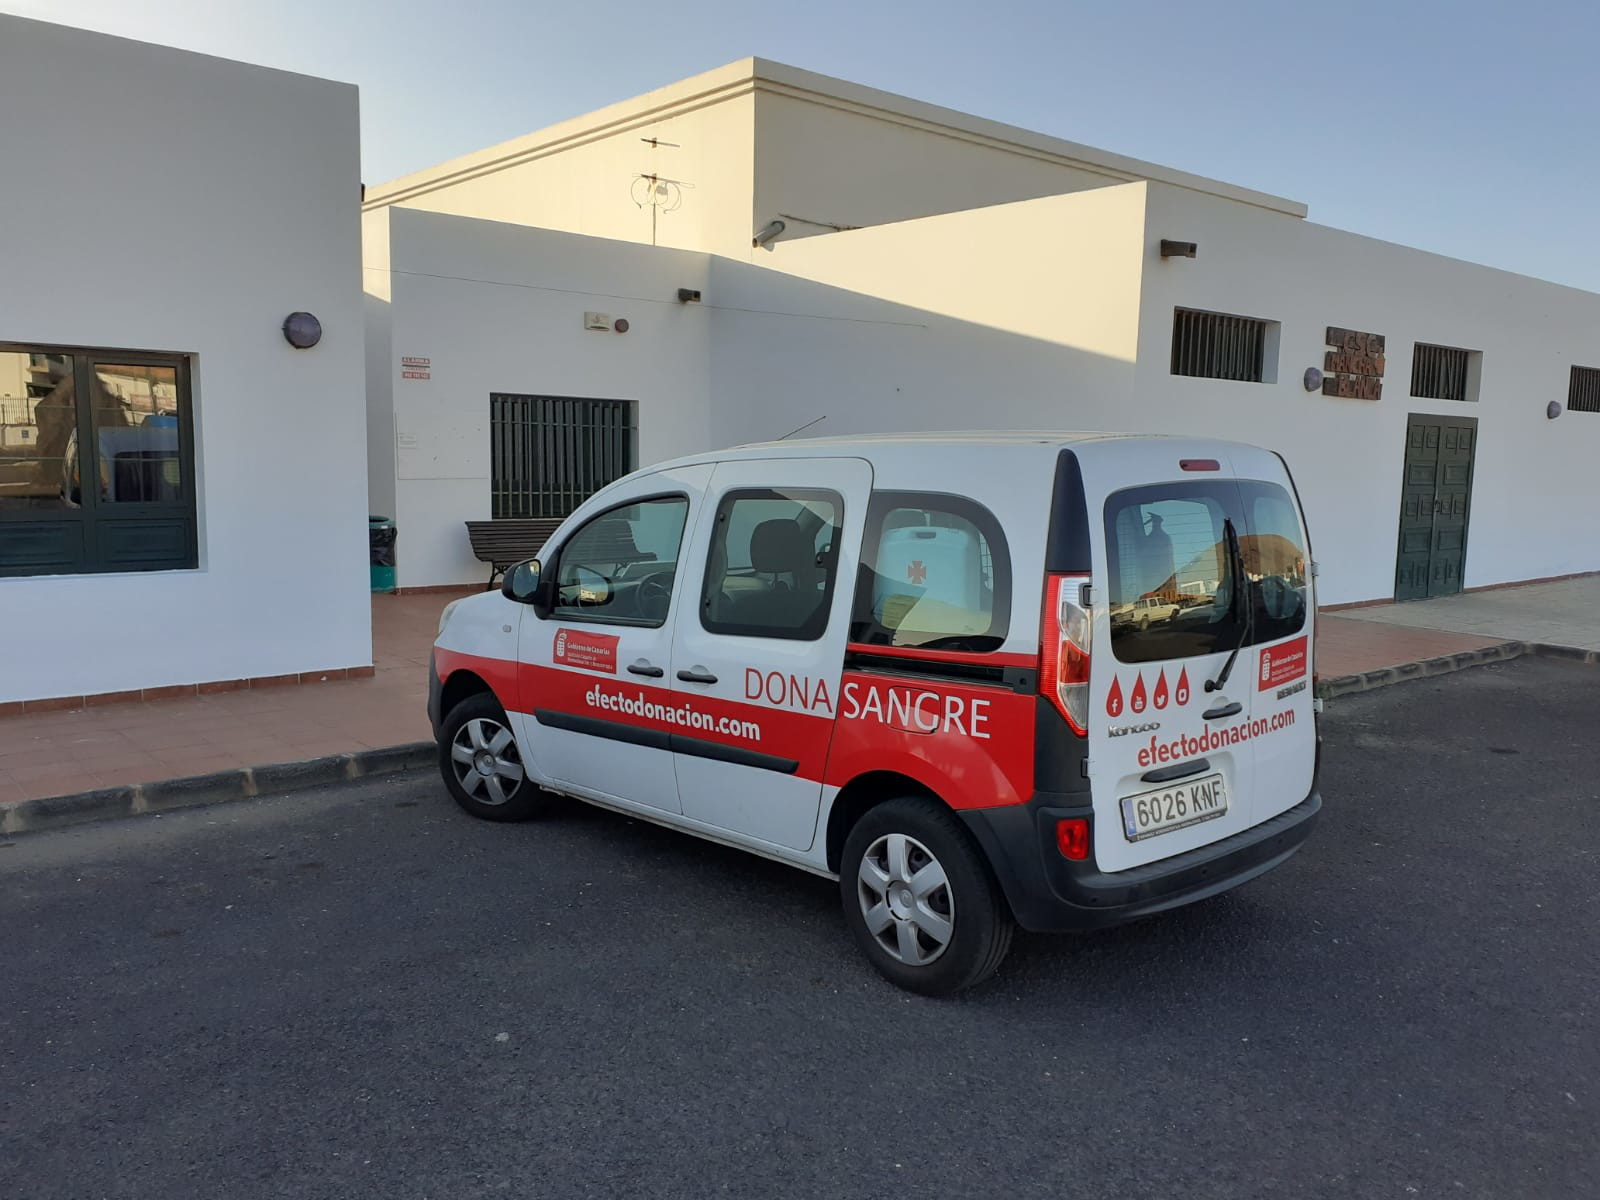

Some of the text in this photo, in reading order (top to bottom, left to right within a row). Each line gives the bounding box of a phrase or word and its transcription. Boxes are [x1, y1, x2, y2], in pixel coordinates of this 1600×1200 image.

[585, 683, 761, 741] efectodonacion.com
[745, 667, 991, 739] DONA SANGRE
[1137, 708, 1295, 767] efectodonacion.com
[1137, 790, 1187, 827] 6026
[1190, 781, 1221, 813] KNF
